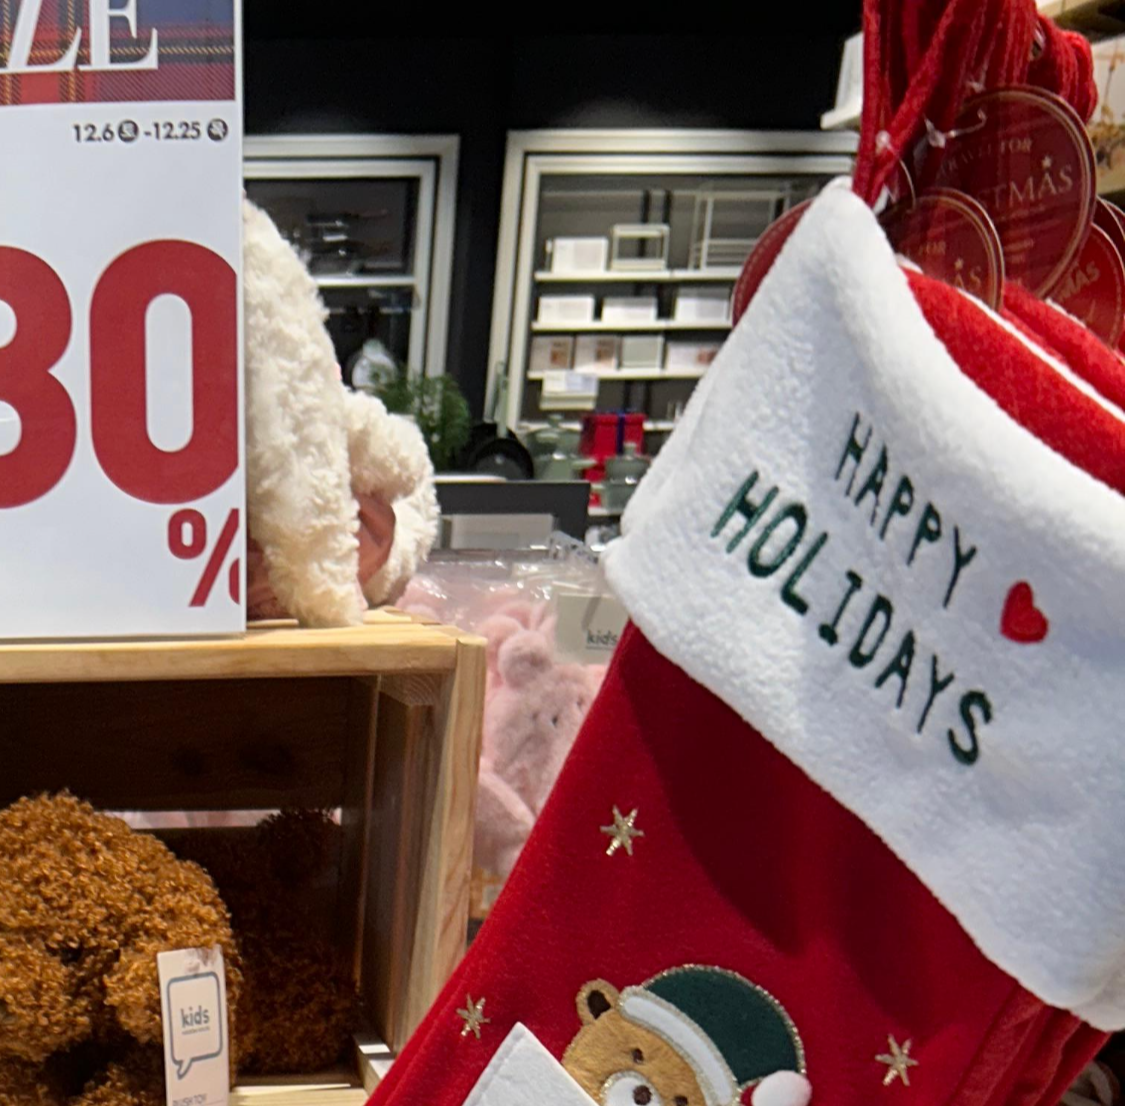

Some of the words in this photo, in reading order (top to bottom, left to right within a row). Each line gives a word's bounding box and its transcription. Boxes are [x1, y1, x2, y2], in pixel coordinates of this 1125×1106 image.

[834, 411, 977, 609] HAPPY
[710, 469, 993, 766] HOLIDAYS
[180, 1005, 211, 1028] kids
